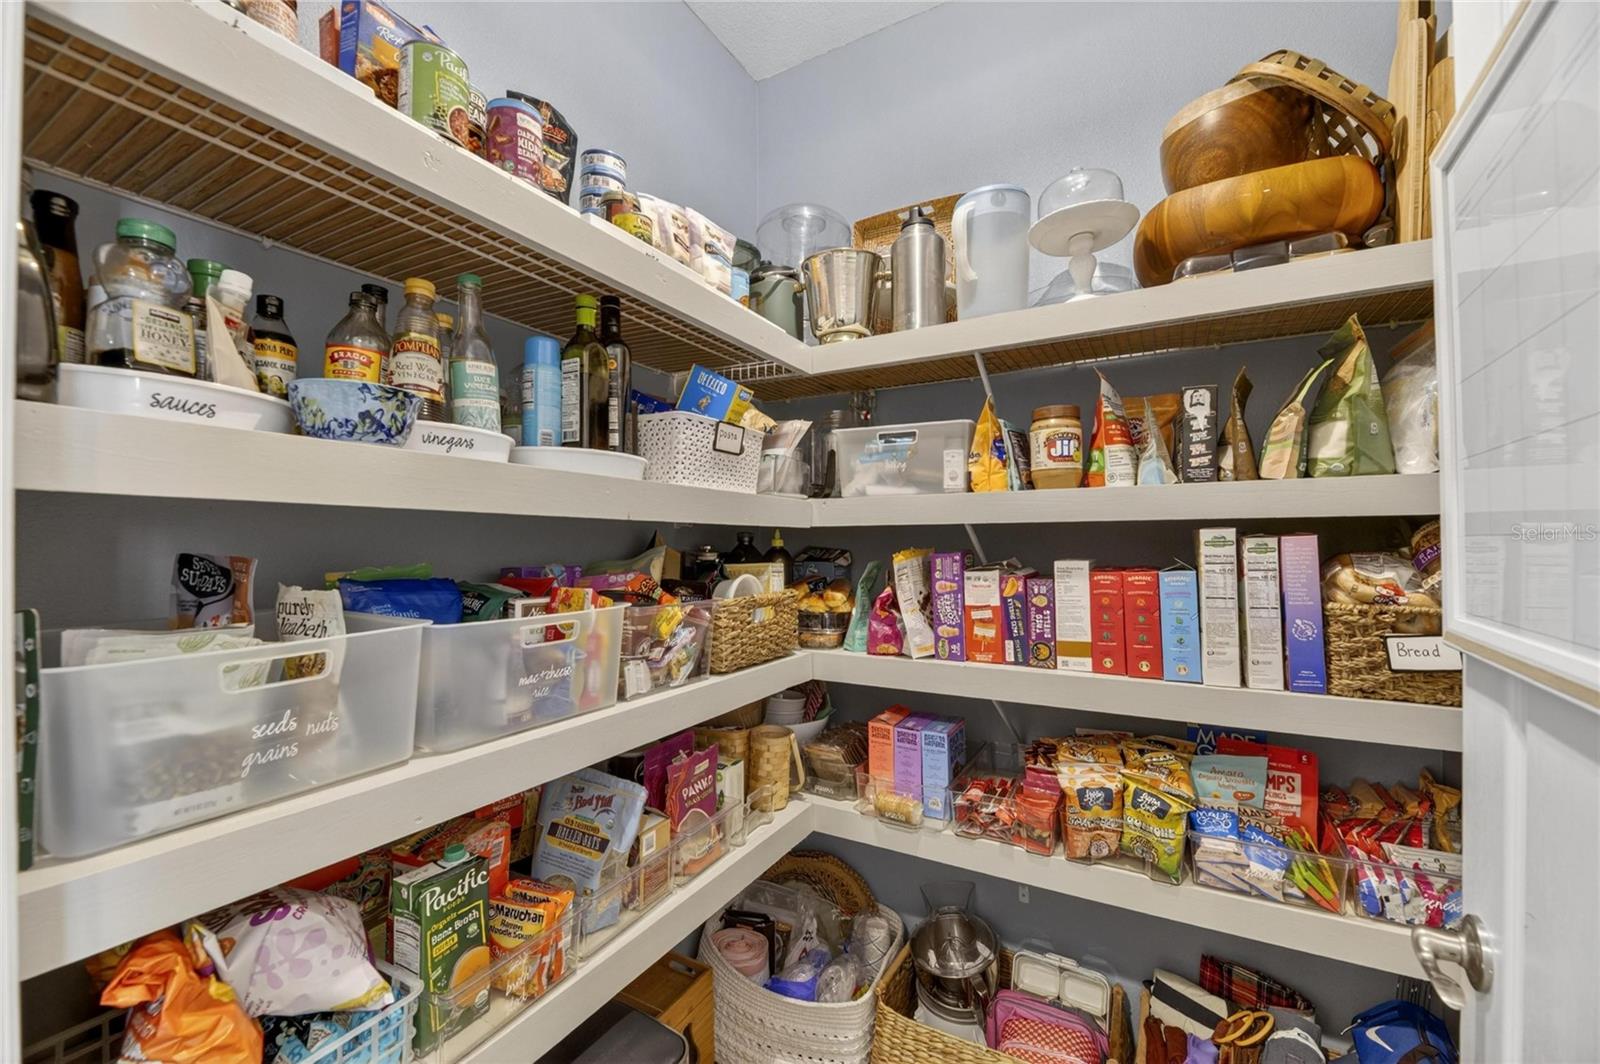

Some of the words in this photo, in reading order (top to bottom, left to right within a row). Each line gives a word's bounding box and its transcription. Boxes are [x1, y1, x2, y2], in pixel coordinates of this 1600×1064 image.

[149, 392, 217, 419] sauces
[422, 431, 475, 454] vinegars
[1050, 438, 1080, 458] Jif
[192, 556, 222, 576] SEVEN
[276, 596, 315, 619] purely
[278, 616, 329, 638] lizabeth
[1396, 641, 1441, 658] Bread
[251, 709, 297, 739] seeds
[305, 711, 339, 736] nuts
[240, 742, 299, 778] grains
[681, 774, 714, 800] PANKO
[1268, 775, 1295, 794] MPS
[419, 867, 490, 917] Pacific
[431, 911, 457, 931] Organic
[494, 903, 545, 924] Maruchan
[431, 926, 453, 945] Bone
[454, 909, 480, 930] Broth
[489, 925, 514, 938] Noodle
